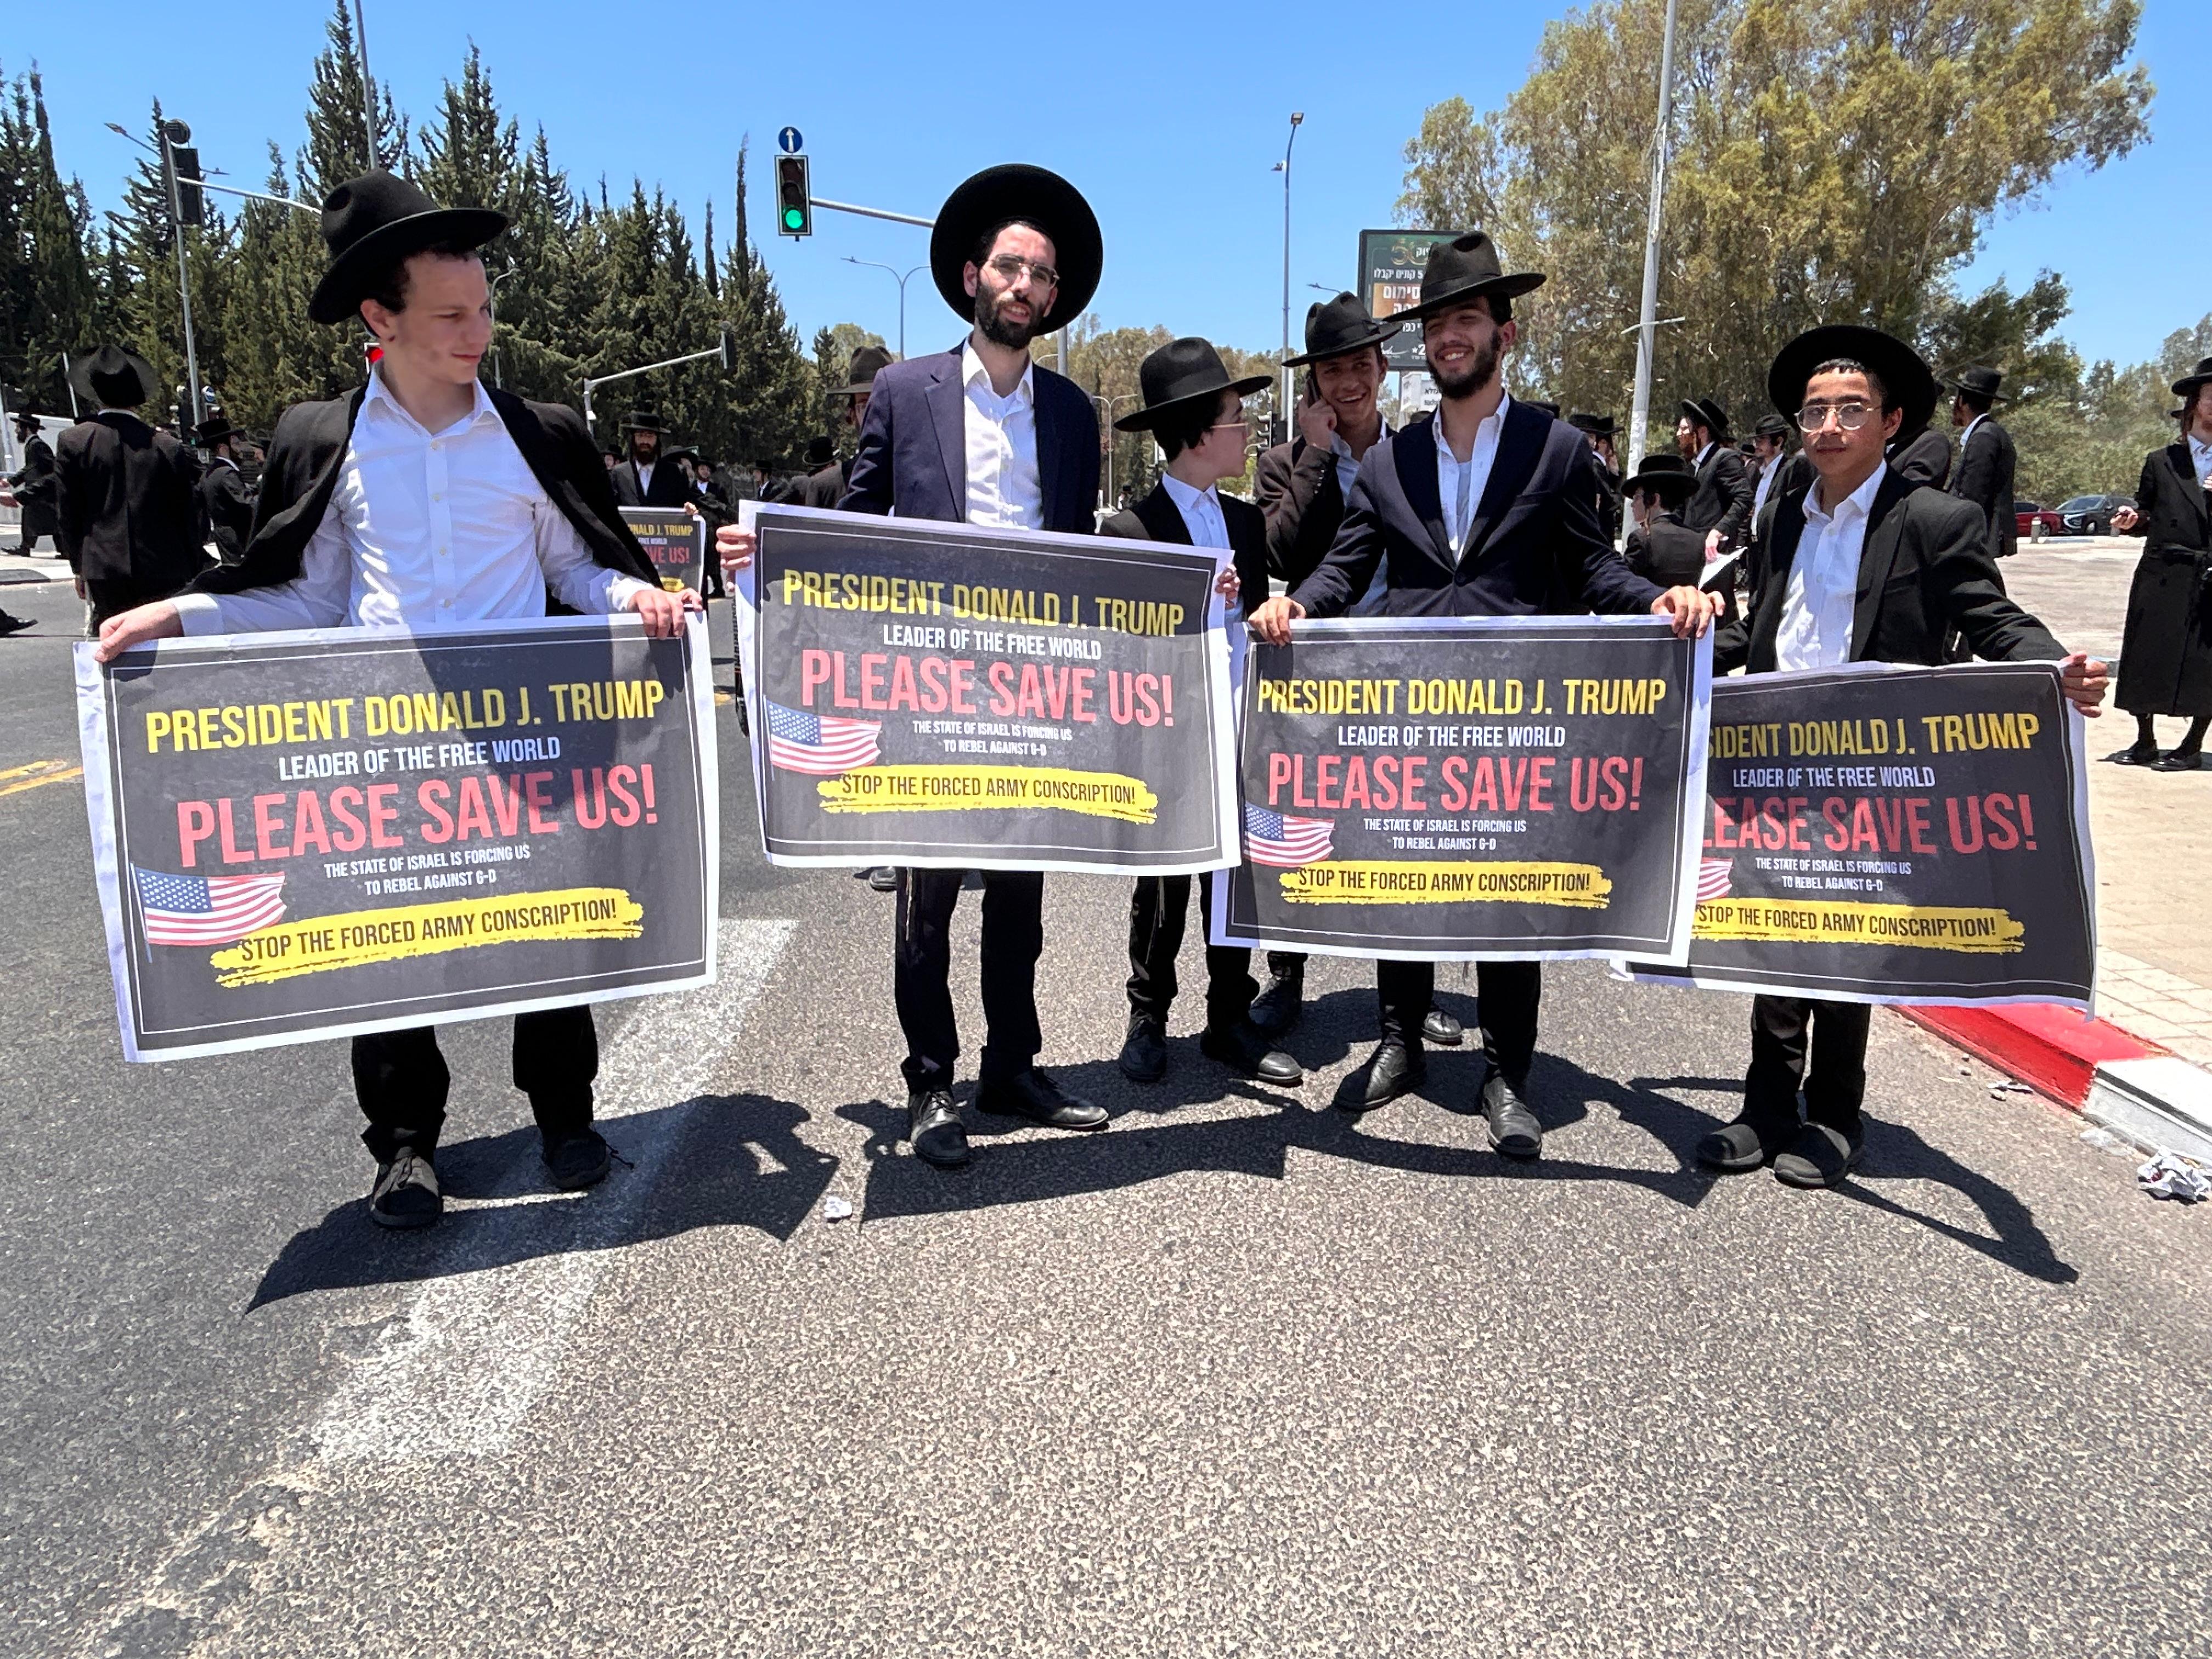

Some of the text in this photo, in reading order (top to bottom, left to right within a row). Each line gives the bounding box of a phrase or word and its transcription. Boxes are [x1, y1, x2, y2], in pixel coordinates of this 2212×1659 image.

[1383, 285, 1421, 299] סימום
[628, 524, 654, 535] NALD
[664, 525, 693, 536] TRUMP
[643, 546, 690, 563] VE US!
[785, 569, 1183, 637] PRESIDENT DONALD J. TRUMP
[884, 625, 1101, 659] LEADER OF THE FREE WORLD
[802, 650, 1172, 726] PLEASE SAVE US!
[1258, 679, 1666, 714] PRESIDENT DONALD J. TRUMP
[146, 680, 663, 753] PRESIDENT DONALD J. TRUMP
[913, 721, 1073, 741] THE STATE OF ISRAEL IS FORCING US
[944, 740, 1047, 756] TO REBEL AGAINST G-D
[1339, 726, 1565, 747] LEADER OF THE FREE WORLD
[1708, 714, 2039, 758] IDENT DONALD J. TRUMP
[279, 737, 560, 781] LEADER OF THE FREE WORLD
[840, 774, 1135, 804] STOP THE FORCED ARMY CONSCRIPTION!
[1269, 753, 1642, 811] PLEASE SAVE US!
[1734, 767, 1935, 787] LEADER OF THE FREE WORLD
[178, 764, 658, 867] PLEASE SAVE US!
[1364, 819, 1526, 832] THE STATE OF ISRAEL IS FORCING US
[1703, 793, 2036, 854] EASE SAVE US!
[1392, 837, 1496, 850] TO REBEL AGAINST G-D
[324, 845, 531, 878] THE STATE OF ISRAEL IS FORCING US
[1756, 857, 1911, 874] THE STATE OF ISRAEL IS FORCING US
[364, 870, 496, 895] TO REBEL AGAINST G-D
[1299, 868, 1589, 891] STOP THE FORCED ARMY CONSCRIPTION!
[1781, 876, 1883, 891] TO REBEL AGAINST G-D
[240, 899, 616, 961] STOP THE FORCED ARMY CONSCRIPTION!
[1699, 904, 1996, 937] STOP THE FORCED ARMY CONSCRIPTION!
